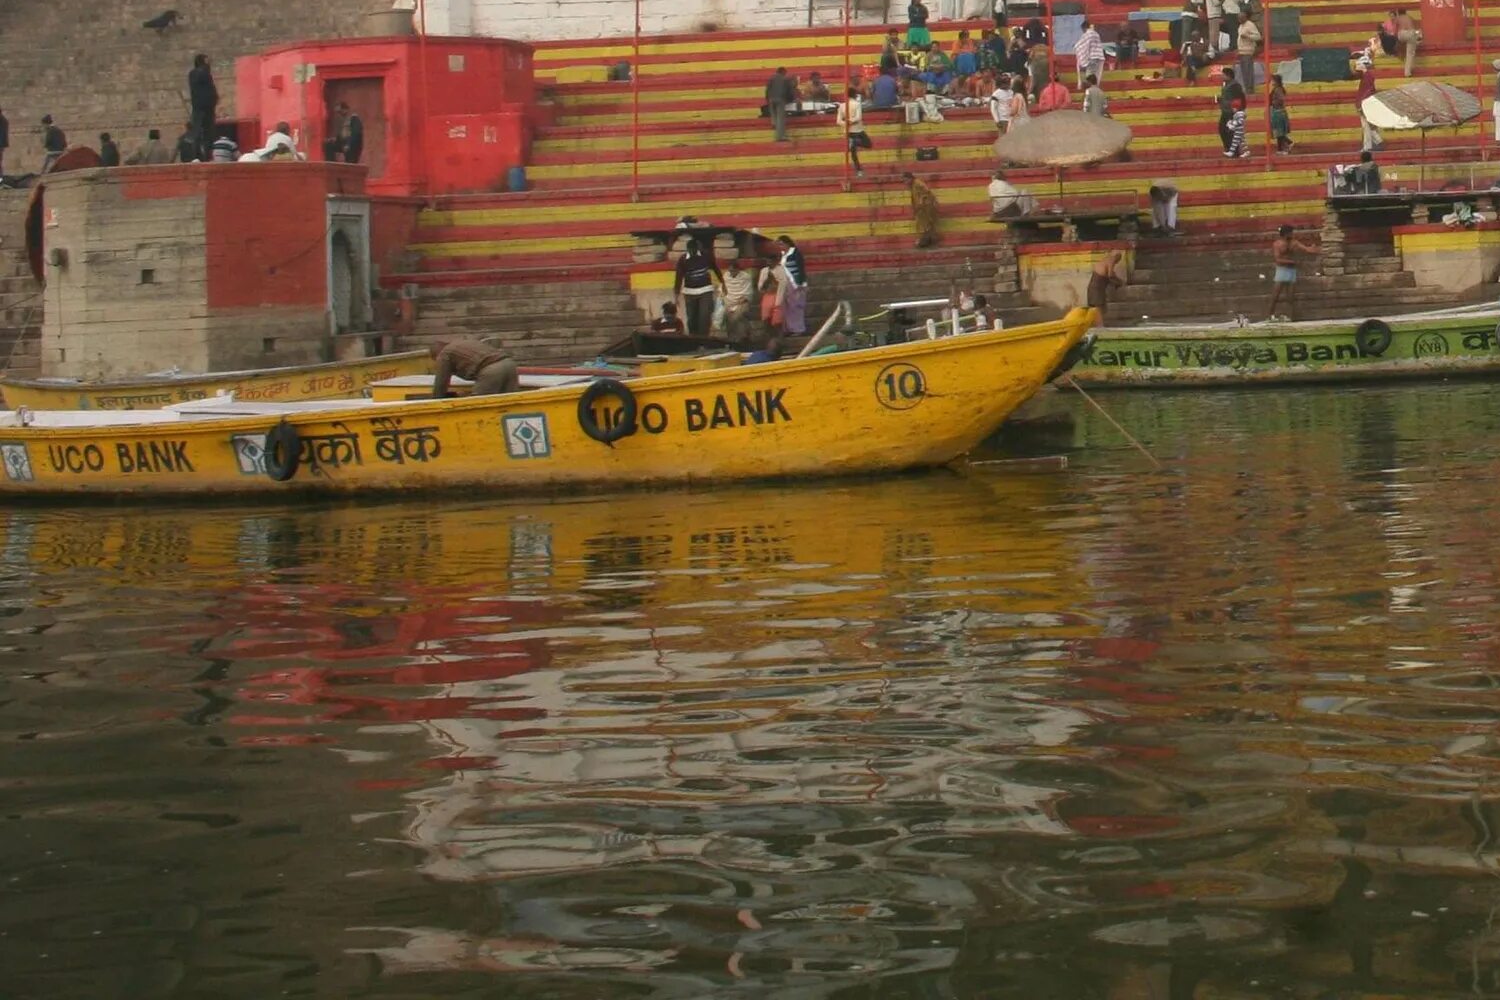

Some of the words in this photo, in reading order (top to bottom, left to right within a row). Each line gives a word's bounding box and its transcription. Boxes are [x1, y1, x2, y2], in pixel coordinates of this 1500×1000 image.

[883, 370, 922, 402] 10
[684, 387, 793, 432] BANK
[48, 444, 105, 474] UCO
[115, 440, 197, 473] BANK
[370, 416, 442, 465] बैंक
